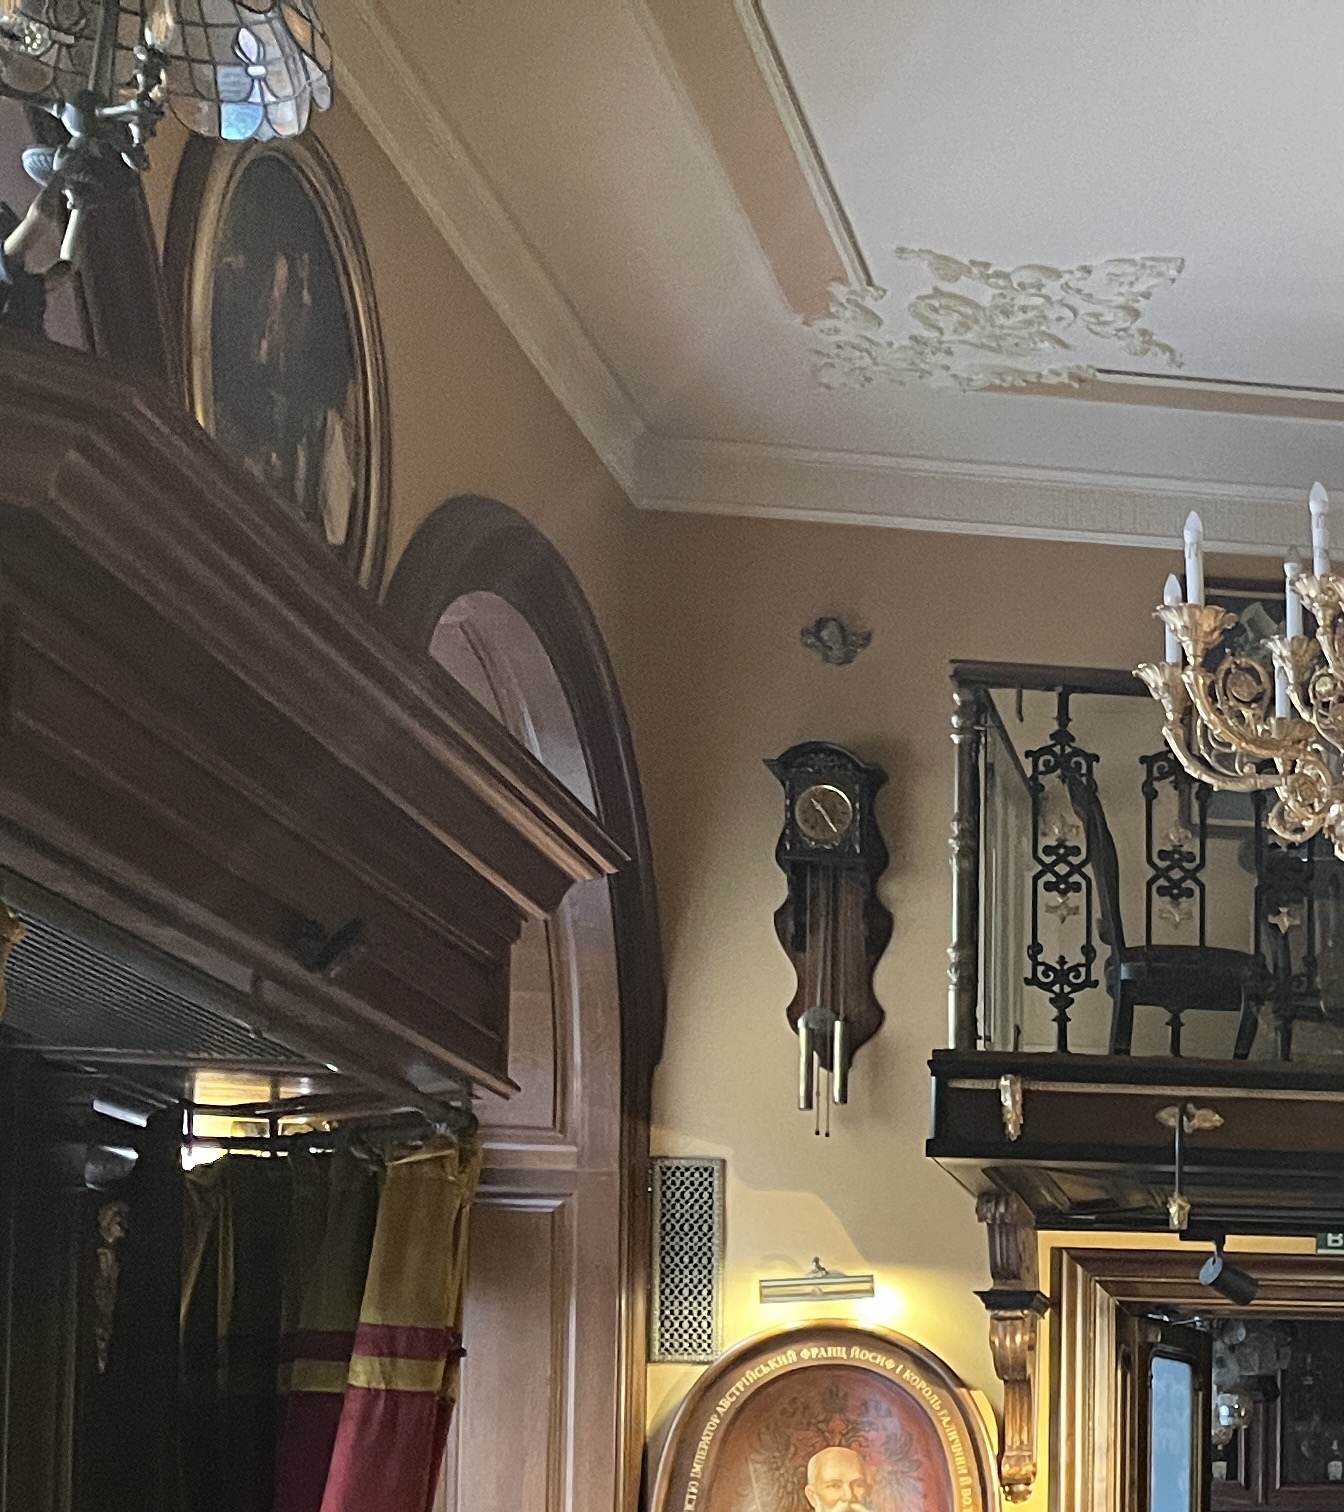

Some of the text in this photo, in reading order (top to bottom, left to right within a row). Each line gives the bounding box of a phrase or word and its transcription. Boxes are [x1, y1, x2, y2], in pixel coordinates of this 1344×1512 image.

[690, 1414, 720, 1478] ІМПЕРАТОР
[716, 1349, 798, 1416] АВСТРІЙСЬКИЙ
[800, 1347, 847, 1359] ФРАНЦ
[850, 1346, 896, 1370] ЙОСИФ
[903, 1369, 942, 1411] КОРОЛЬ
[938, 1409, 968, 1475] ГАЛИЧИНИ
